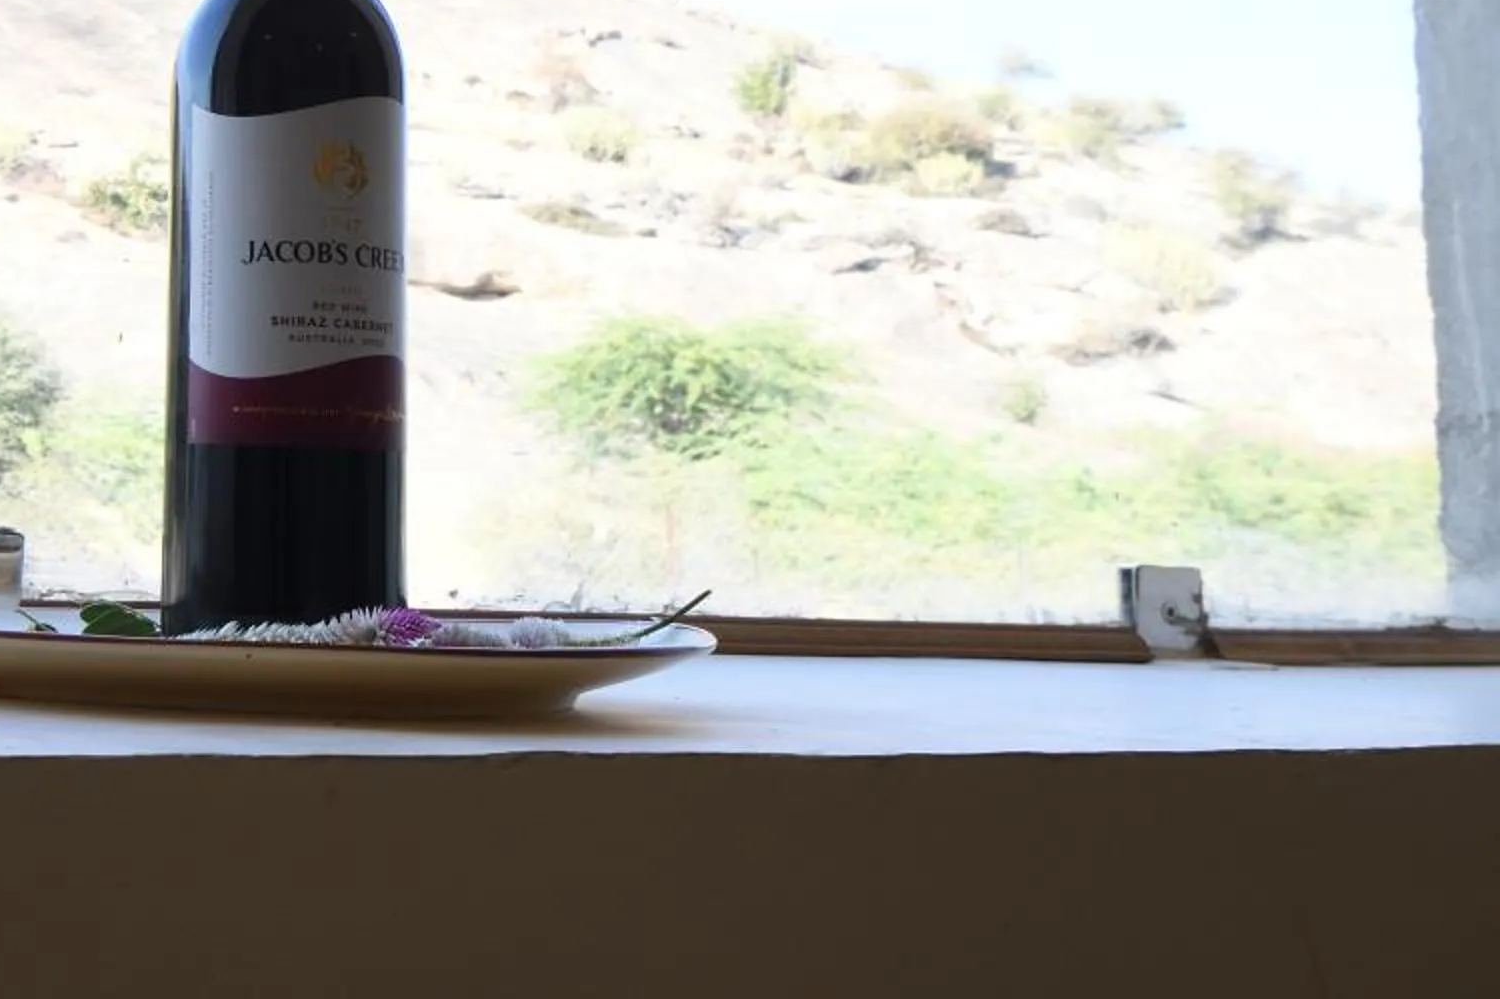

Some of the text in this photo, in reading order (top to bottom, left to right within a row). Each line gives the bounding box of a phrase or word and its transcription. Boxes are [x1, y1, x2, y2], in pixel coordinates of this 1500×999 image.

[242, 239, 349, 265] JACOB'S
[271, 315, 329, 328] SHIRAZ
[288, 333, 355, 346] AUSTRALIA
